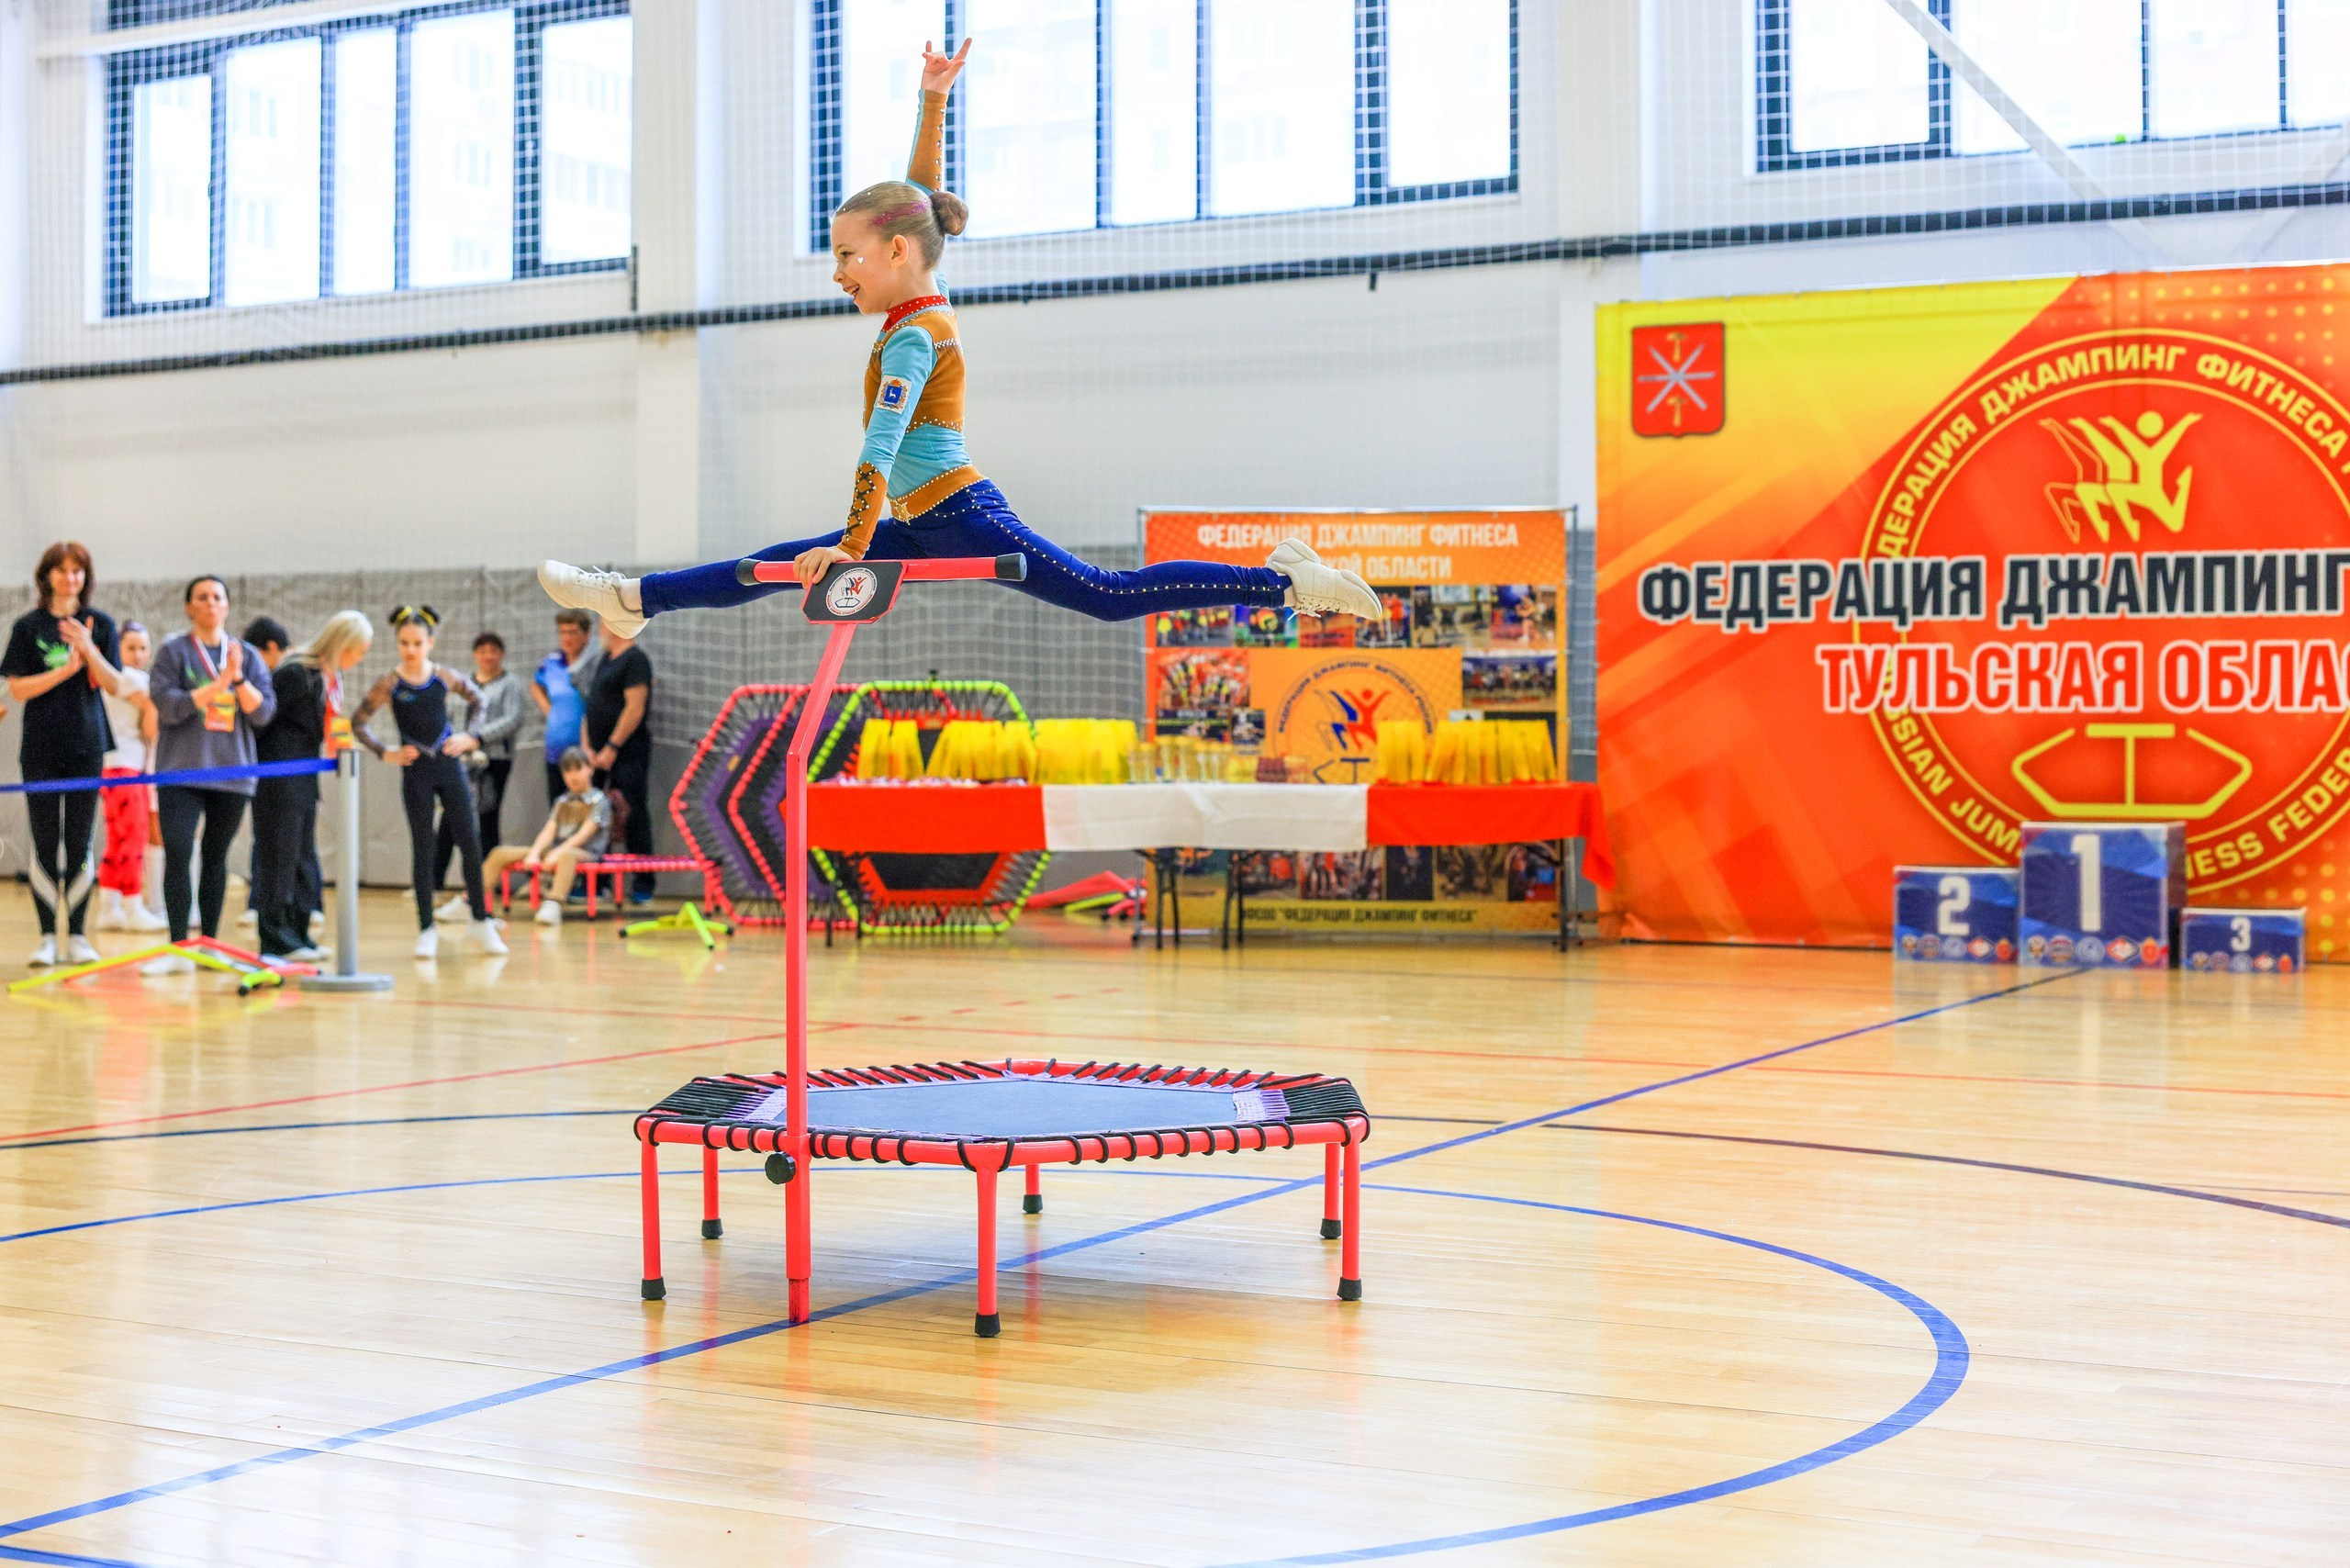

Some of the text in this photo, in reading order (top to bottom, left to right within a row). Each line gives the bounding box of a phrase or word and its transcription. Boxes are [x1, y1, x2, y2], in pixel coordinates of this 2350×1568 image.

[1877, 345, 2348, 558] ДЕРАЦИЯ ДЖАМПИНГ ФИТНЕСА
[1197, 521, 1519, 549] ФЕДЕРАЦИЯ ДЖАМПИНГ ФИТНЕСА
[1366, 554, 1452, 580] ОБЛАСТИ
[1639, 548, 2350, 633] ФЕДЕРАЦИЯ ДЖАМПИНГ
[1815, 639, 2350, 714] ТУЛЬСКАЯ ОБЛА
[1937, 875, 1972, 936] 2
[2071, 834, 2102, 934] 1
[2231, 917, 2253, 953] 3
